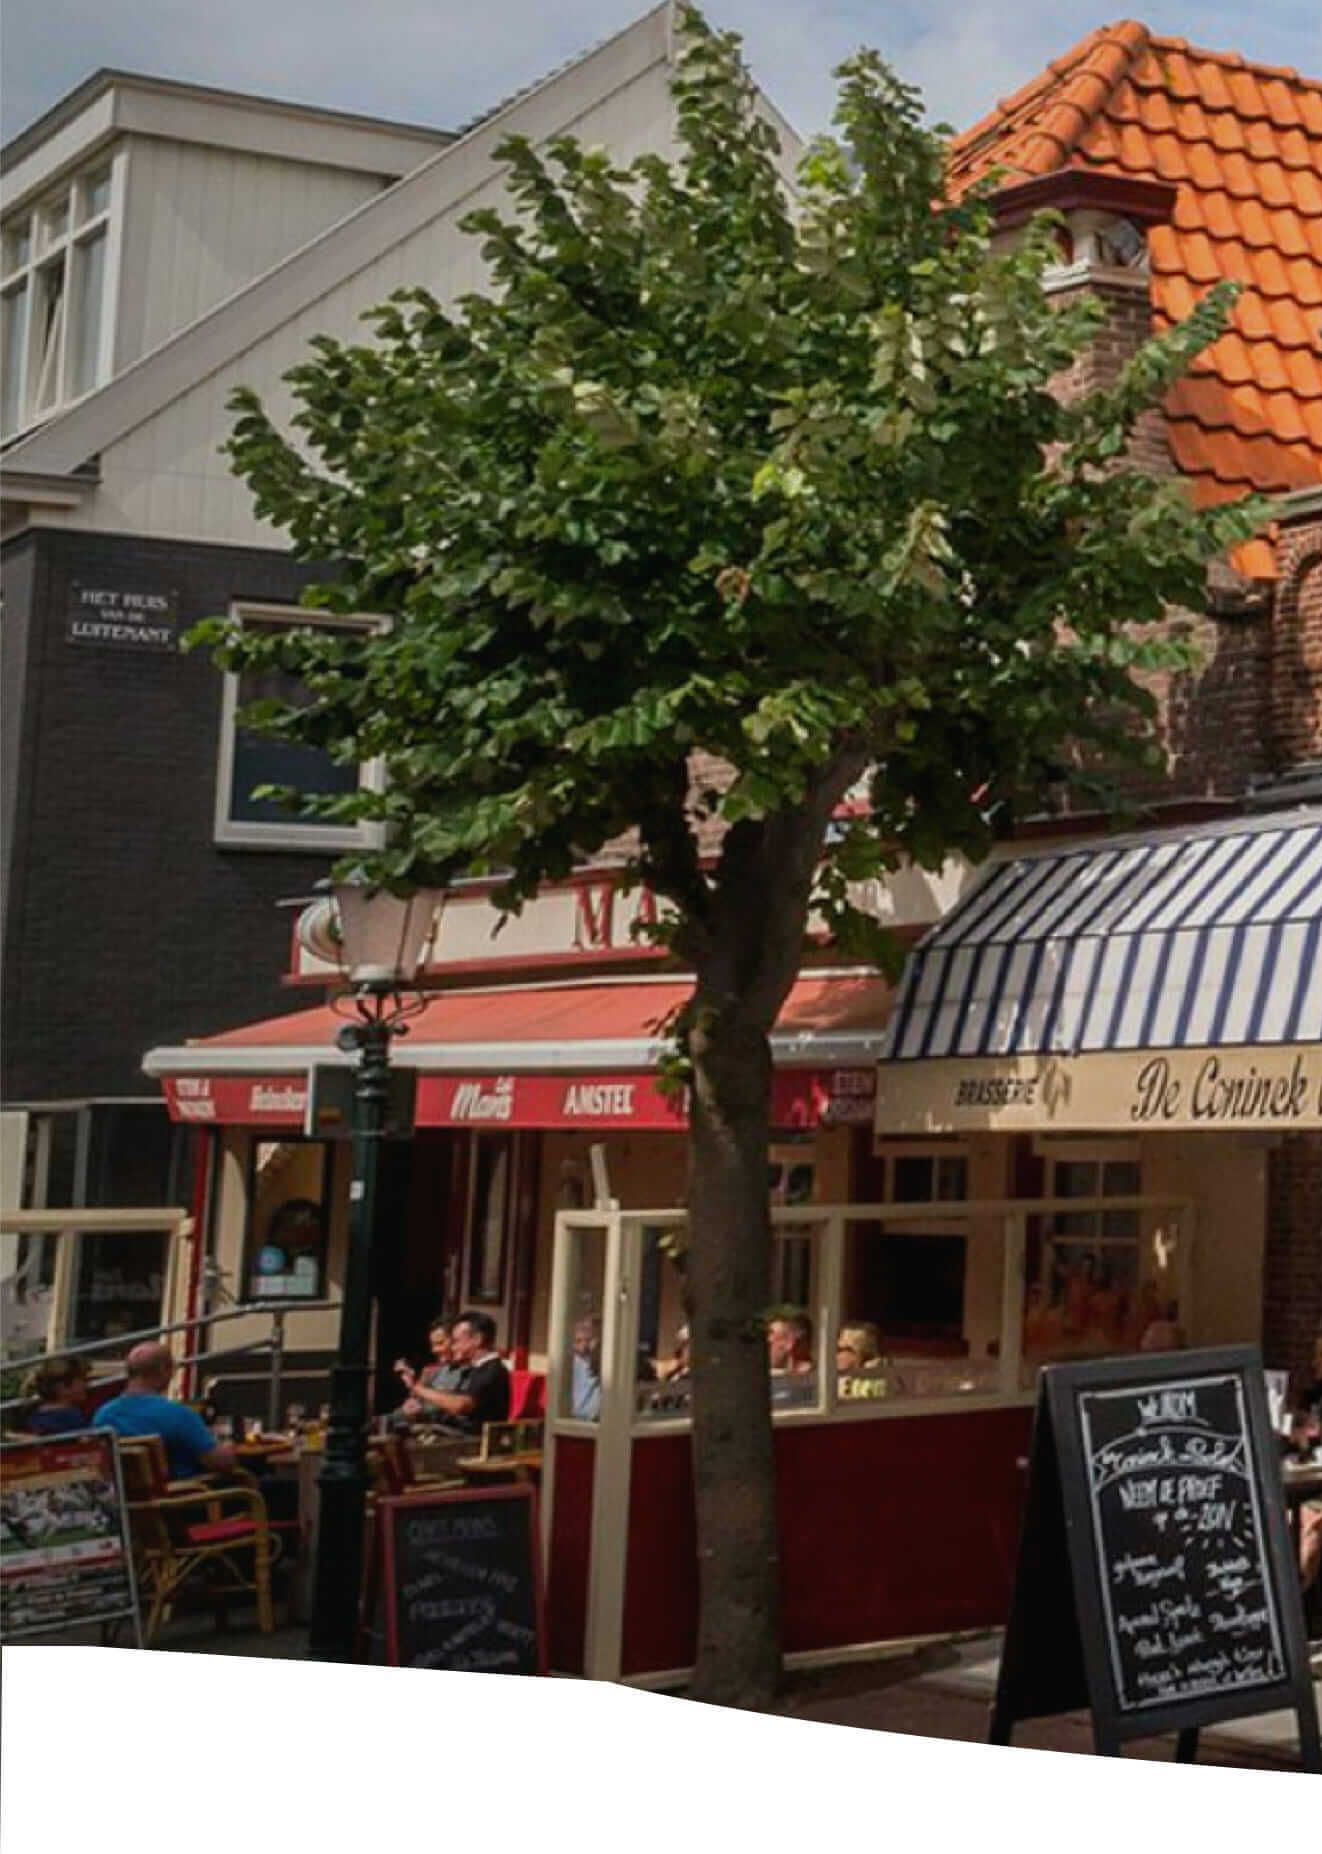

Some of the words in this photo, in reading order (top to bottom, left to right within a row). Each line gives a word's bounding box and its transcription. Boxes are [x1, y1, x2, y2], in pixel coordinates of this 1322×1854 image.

[563, 1084, 636, 1116] AMSTEL
[954, 1077, 1039, 1107] BRASSERIE
[1130, 1056, 1181, 1120] De
[1191, 1052, 1308, 1121] Coninck
